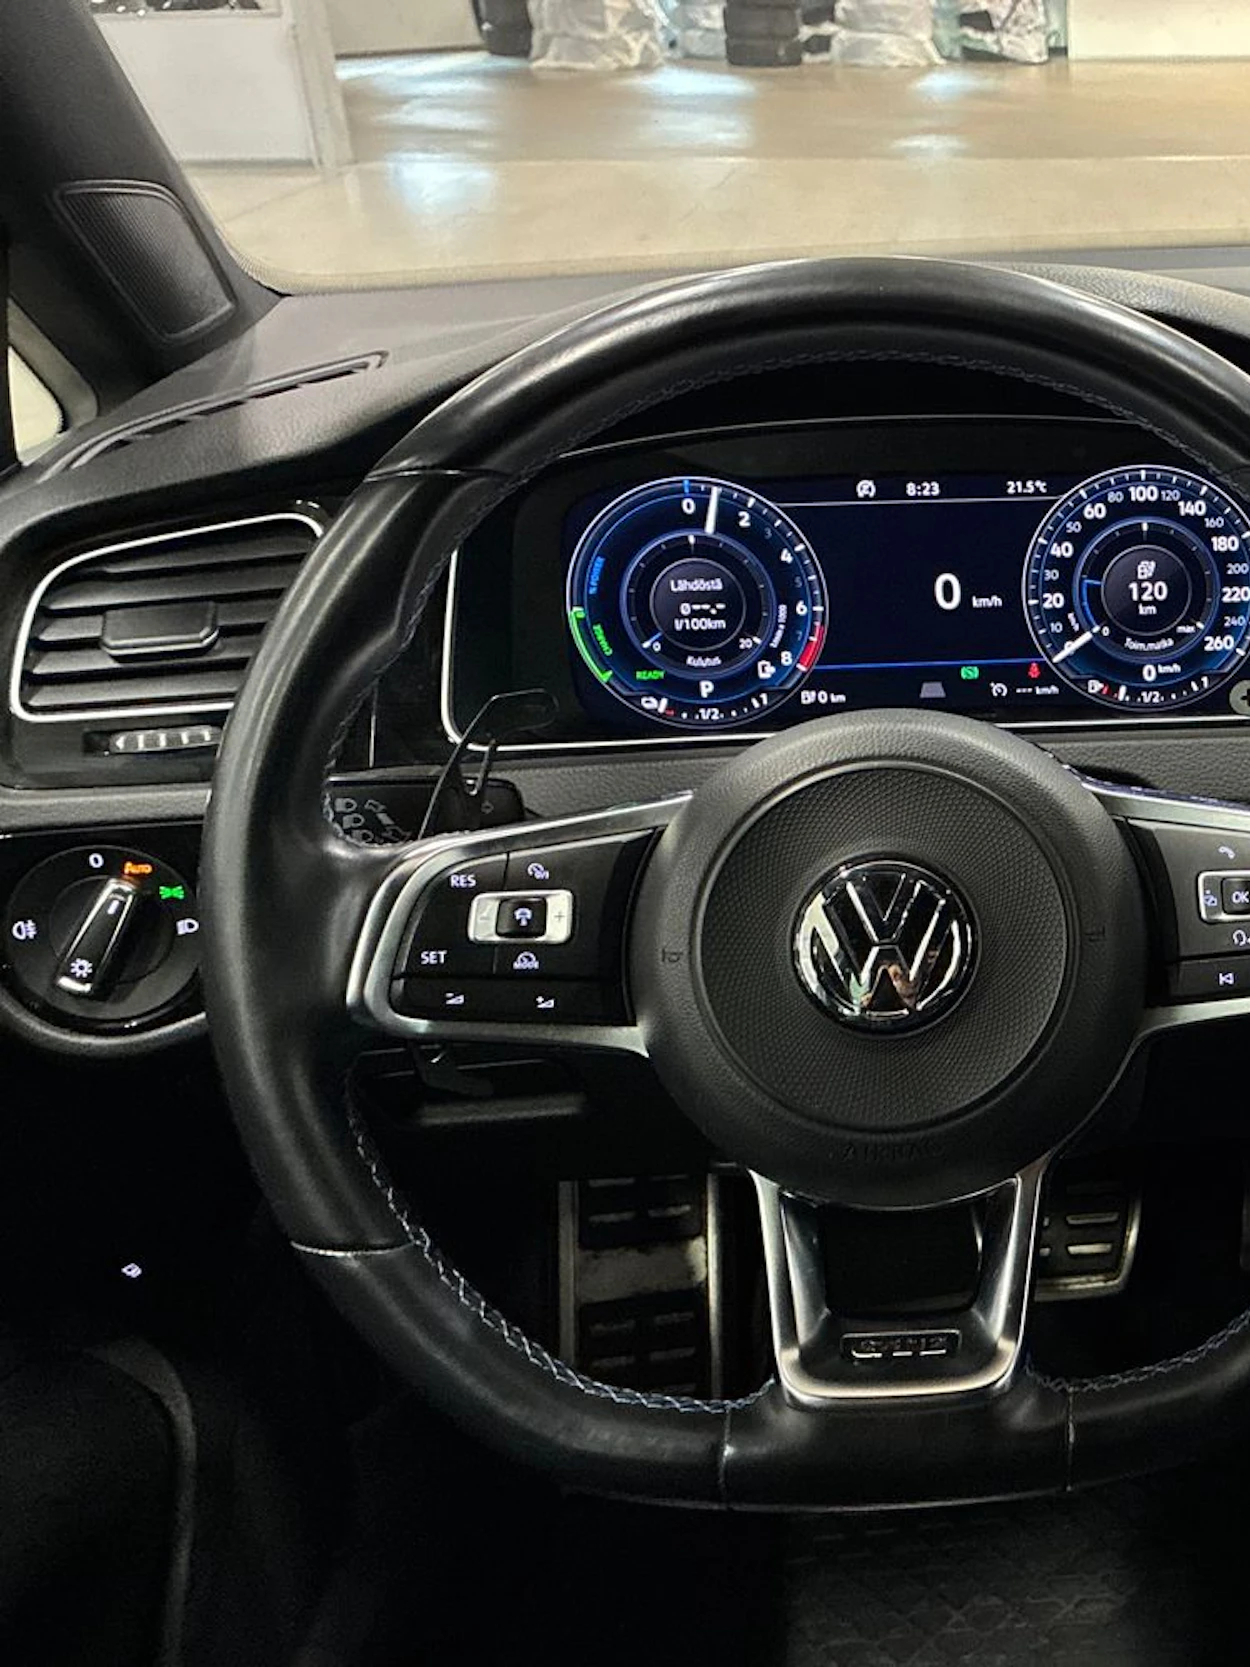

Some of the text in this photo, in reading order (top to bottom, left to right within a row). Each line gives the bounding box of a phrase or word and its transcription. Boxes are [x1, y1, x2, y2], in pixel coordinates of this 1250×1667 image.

[906, 481, 939, 495] 8:23
[1128, 485, 1157, 501] 100
[1161, 489, 1180, 500] 120
[1107, 491, 1123, 501] 80
[682, 498, 695, 514] 0
[1083, 503, 1106, 518] 60
[1178, 501, 1206, 516] 140
[738, 511, 751, 527] 2
[1204, 517, 1223, 528] 160
[1066, 521, 1081, 532] 50
[1051, 541, 1073, 557] 40
[1211, 536, 1239, 551] 180
[780, 548, 793, 563] 4
[1044, 569, 1058, 580] 30
[1226, 562, 1248, 574] 200
[934, 572, 1002, 610] 0 km/h
[1128, 581, 1167, 600] 120
[1222, 586, 1250, 602] 220
[795, 600, 808, 615] 6
[1043, 593, 1064, 608] 20
[1138, 604, 1156, 615] km
[1050, 621, 1063, 632] 10
[1224, 616, 1244, 627] 240
[1102, 626, 1110, 636] 0
[1176, 625, 1195, 634] max
[652, 641, 661, 652] 0
[739, 638, 752, 649] 20
[1204, 635, 1234, 650] 260
[780, 650, 793, 665] 8
[1142, 664, 1181, 681] 0 km/h
[700, 681, 713, 697] P
[817, 690, 845, 702] 0 km
[1142, 691, 1160, 702] 1/2
[699, 708, 719, 719] 1/2
[450, 873, 476, 887] RES
[1232, 891, 1249, 903] OK
[793, 857, 977, 1034] VW
[420, 950, 446, 964] SET
